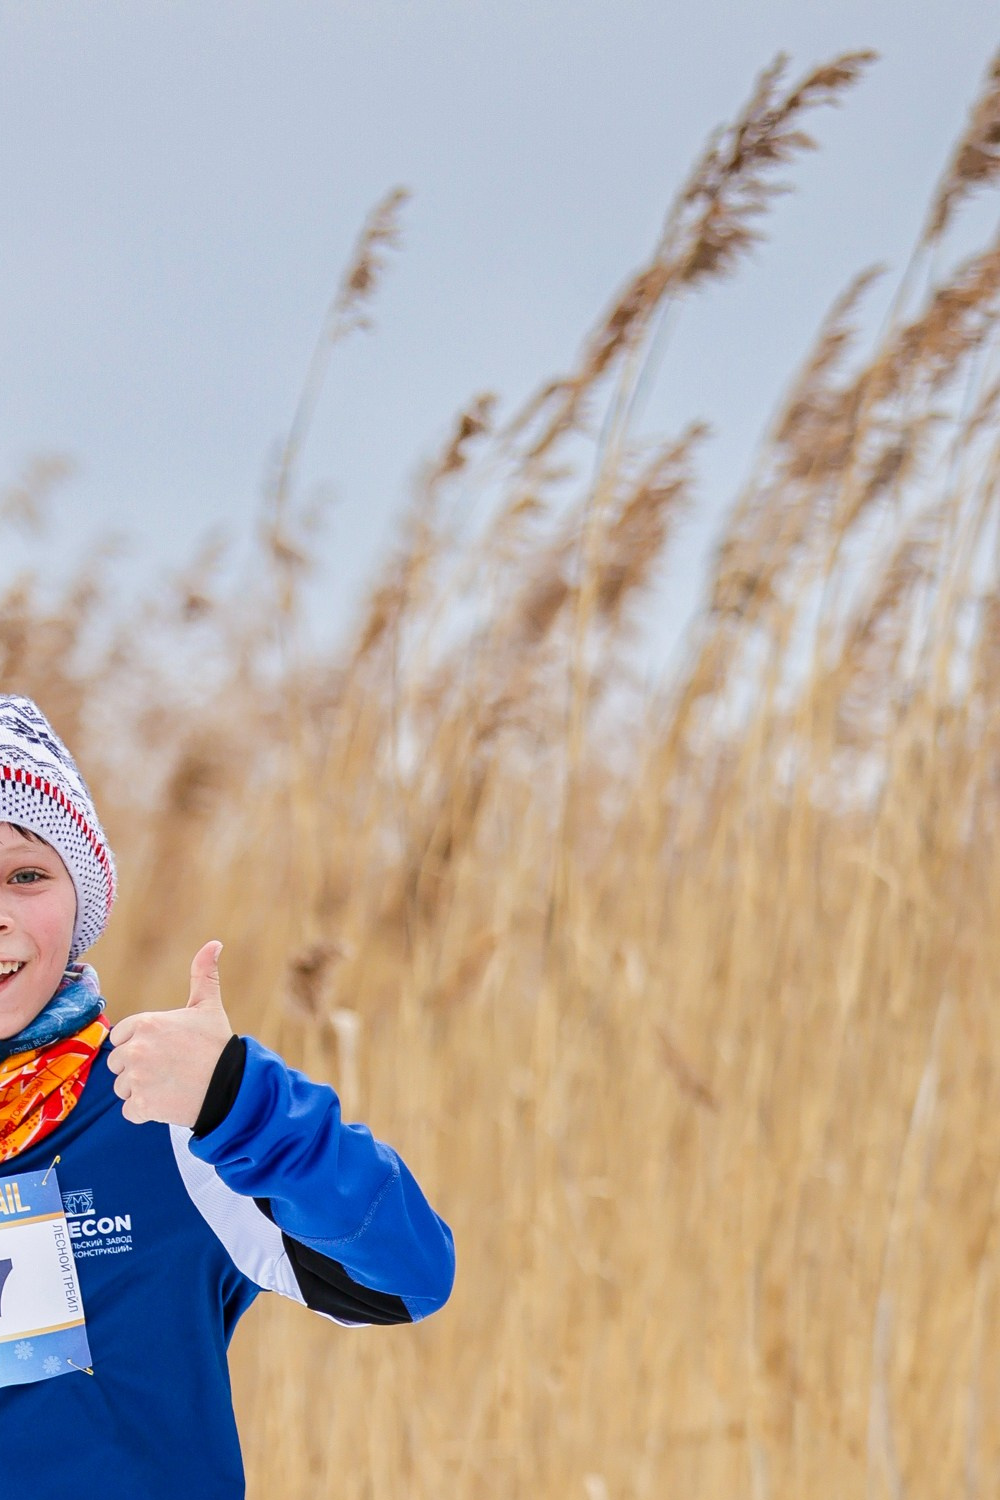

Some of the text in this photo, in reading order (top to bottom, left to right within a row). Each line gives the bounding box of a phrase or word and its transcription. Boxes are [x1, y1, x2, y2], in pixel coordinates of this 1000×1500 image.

[67, 1214, 132, 1239] ECON
[72, 1235, 133, 1250] ЛЬСКИЙ ЗАВОД
[53, 1225, 79, 1313] ЛЕСНОЙ ТРЕЙЛ
